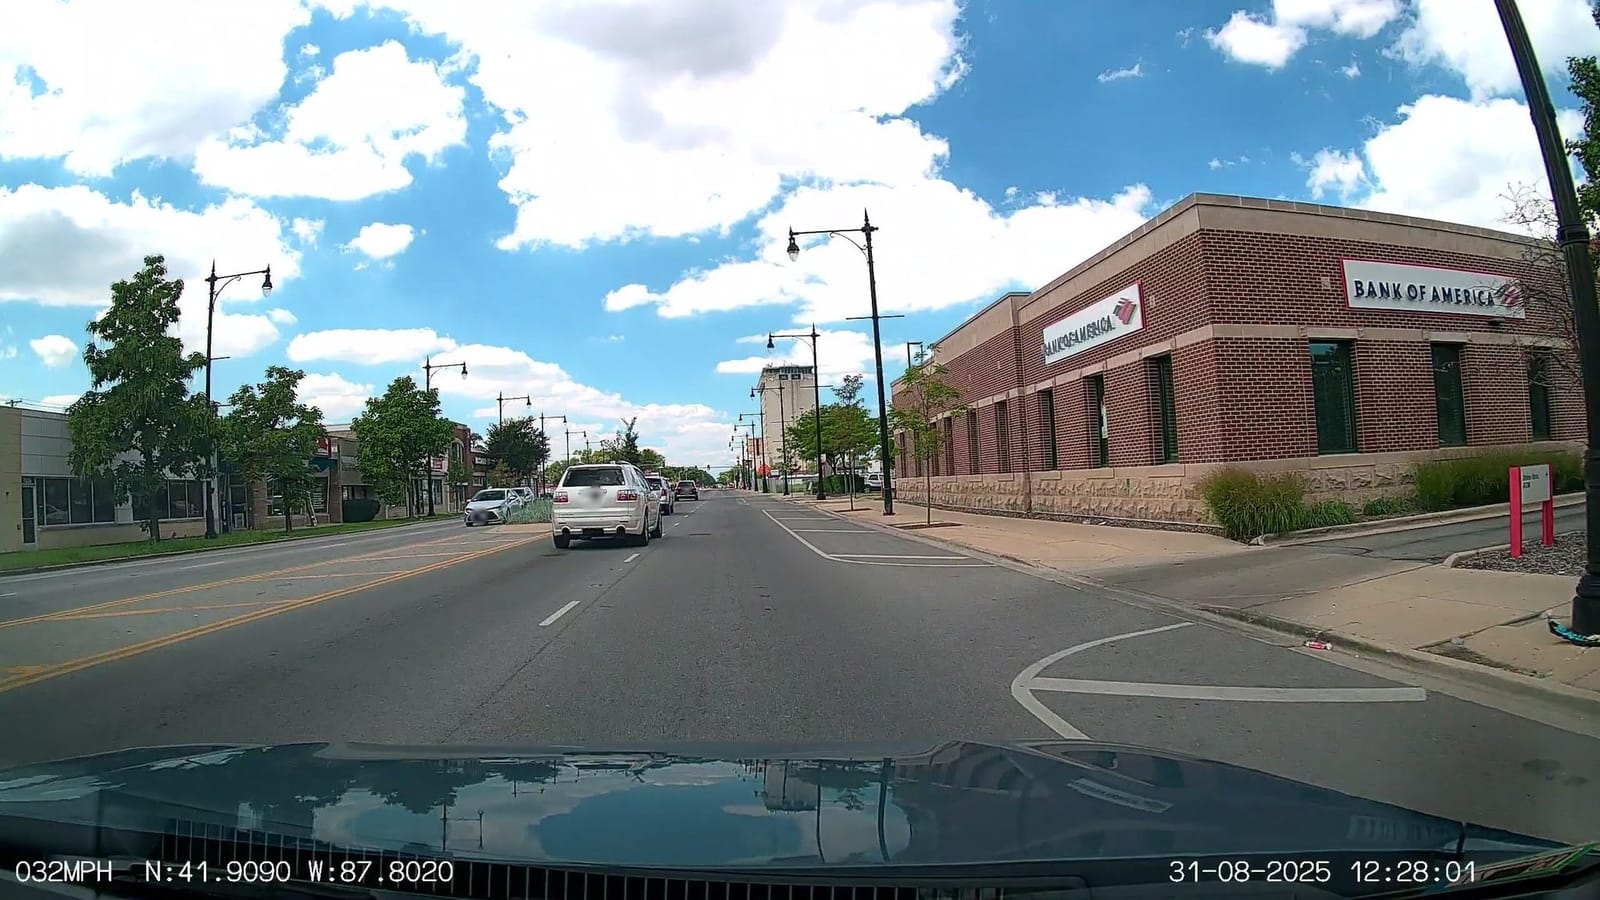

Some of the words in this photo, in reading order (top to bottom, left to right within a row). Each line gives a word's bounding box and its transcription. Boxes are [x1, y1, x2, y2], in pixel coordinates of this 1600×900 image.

[1353, 280, 1403, 300] BANK
[1407, 283, 1426, 301] OF
[1429, 286, 1496, 307] AMERICA
